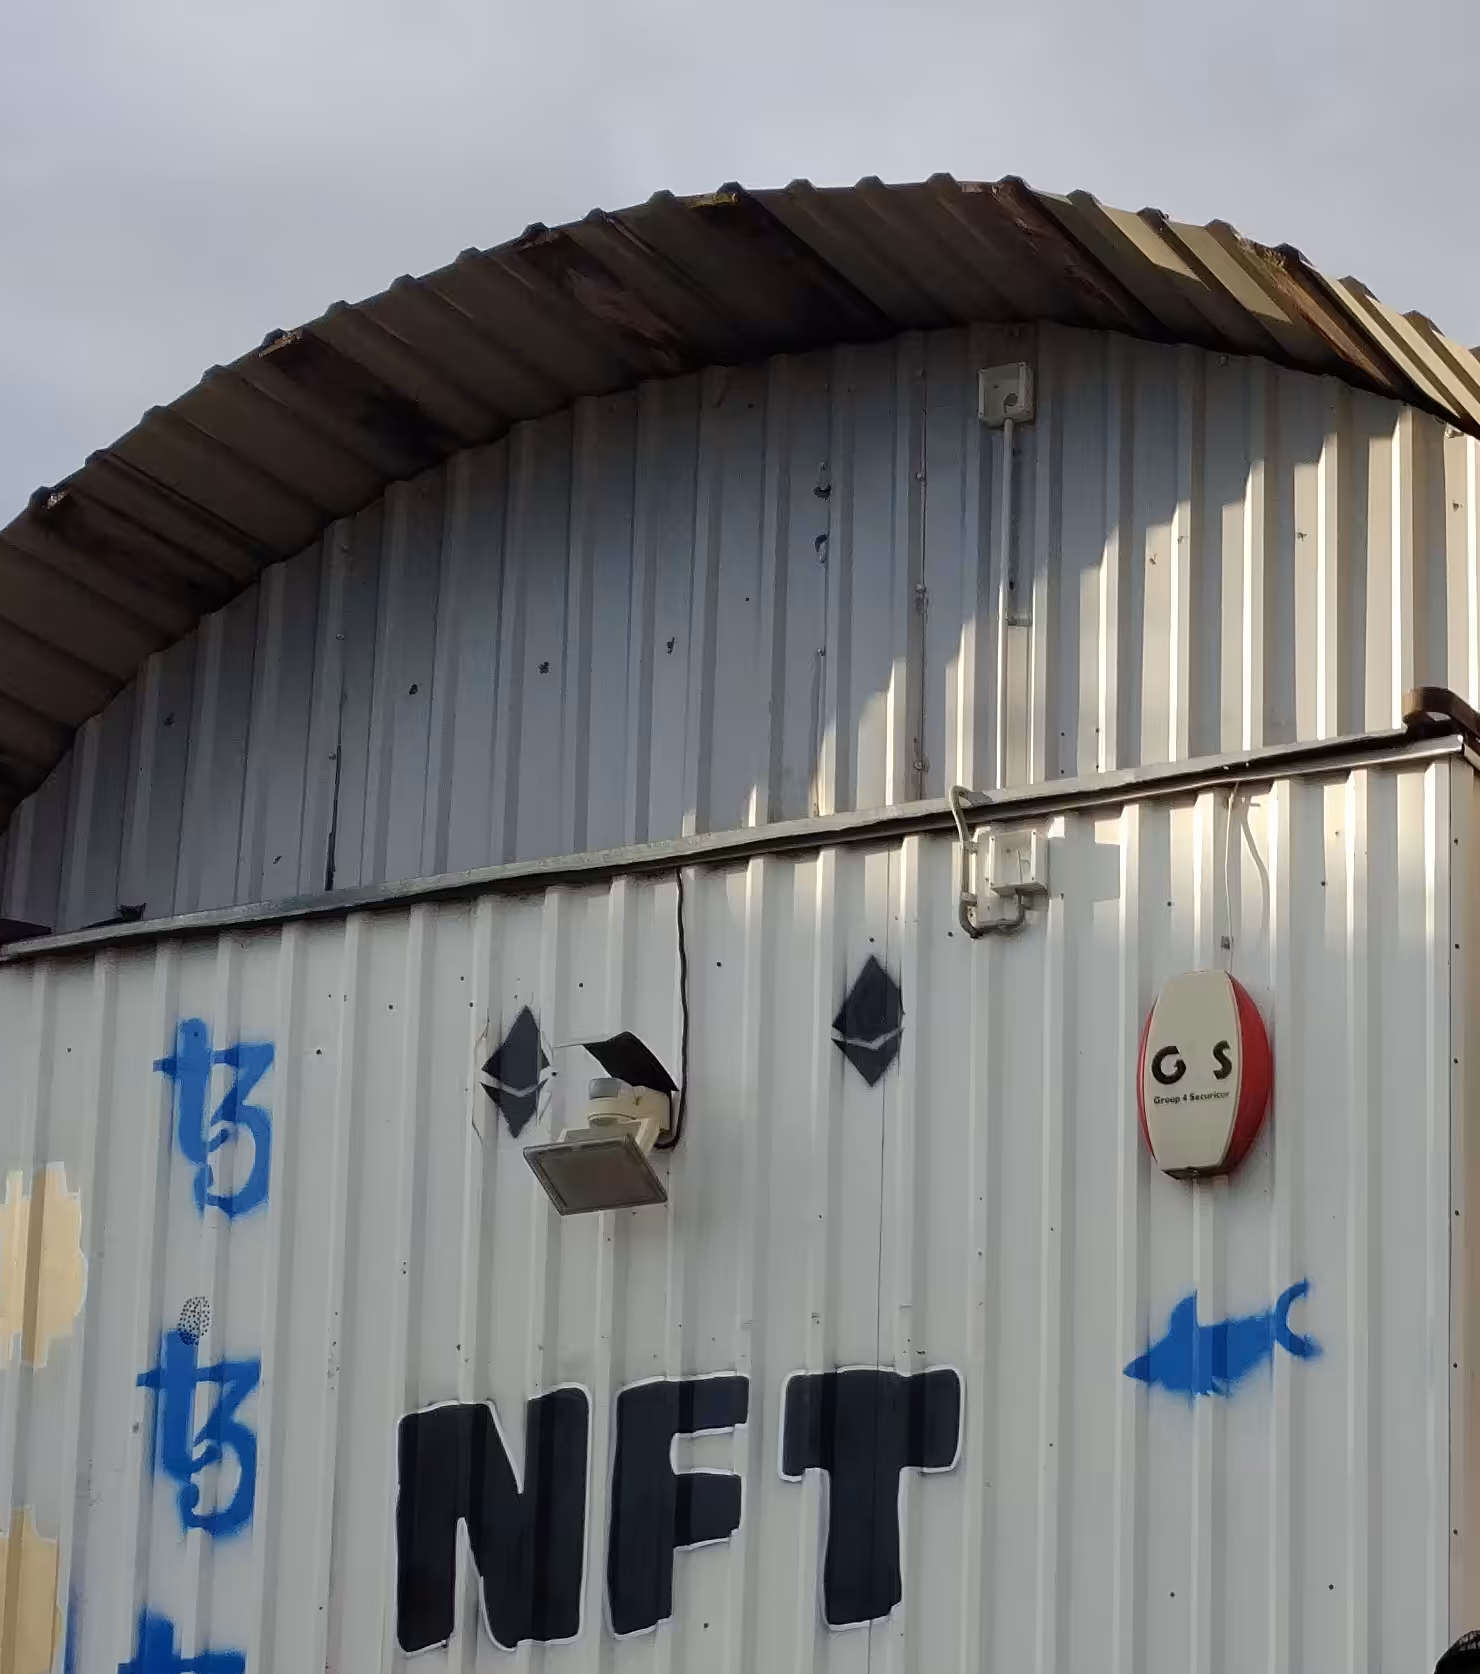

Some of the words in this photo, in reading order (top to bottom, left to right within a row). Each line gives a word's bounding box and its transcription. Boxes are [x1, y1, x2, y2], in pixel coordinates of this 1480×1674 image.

[1153, 1095, 1180, 1104] Group
[1189, 1091, 1230, 1101] Securicor
[395, 1364, 965, 1656] NFT
